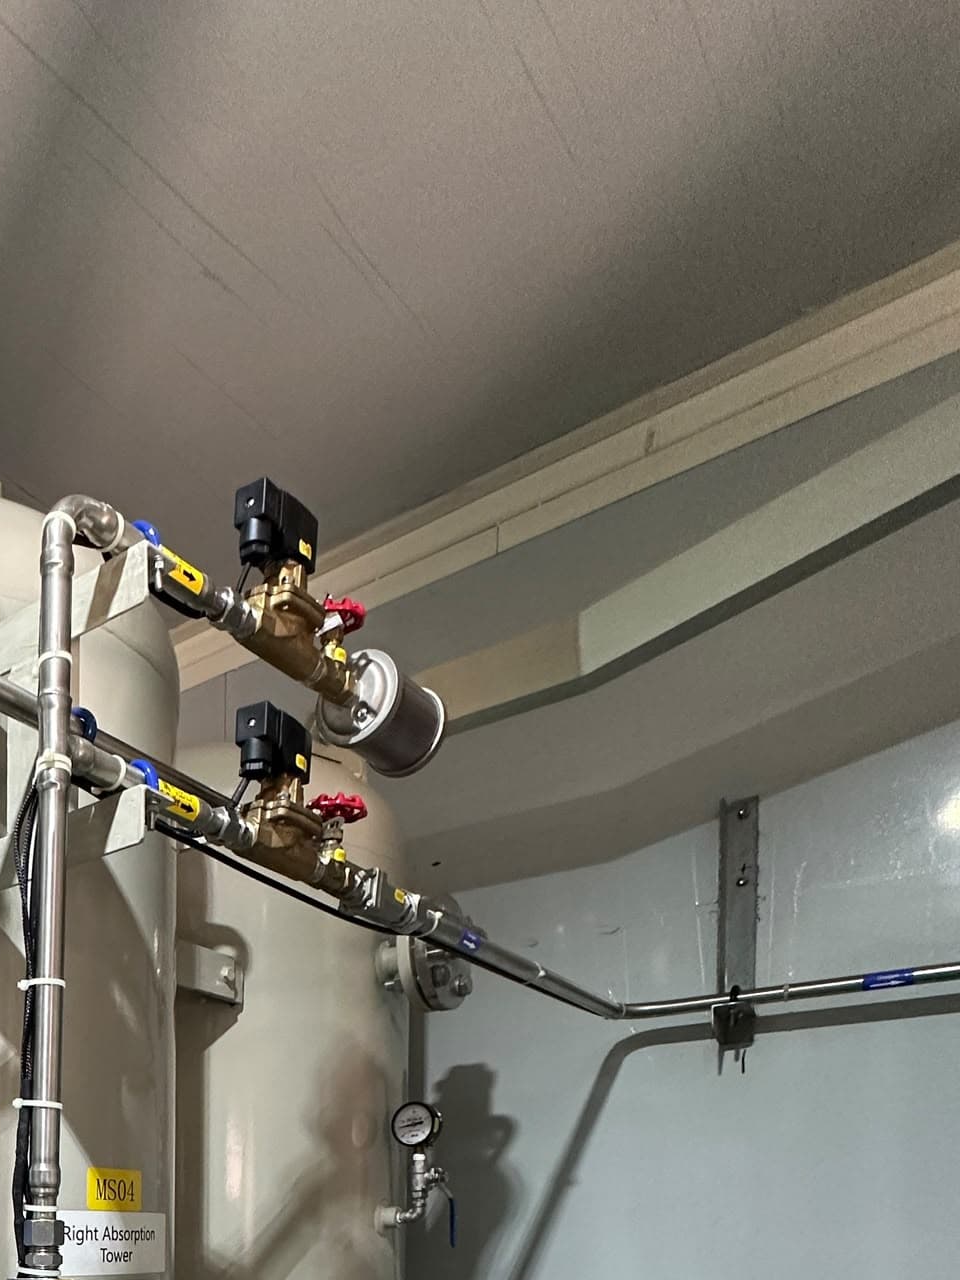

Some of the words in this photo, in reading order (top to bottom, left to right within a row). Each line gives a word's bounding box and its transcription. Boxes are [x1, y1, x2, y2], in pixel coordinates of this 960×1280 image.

[96, 1178, 135, 1201] MS04
[63, 1225, 99, 1245] Right
[102, 1225, 156, 1244] Absorption
[100, 1248, 133, 1262] Tower
